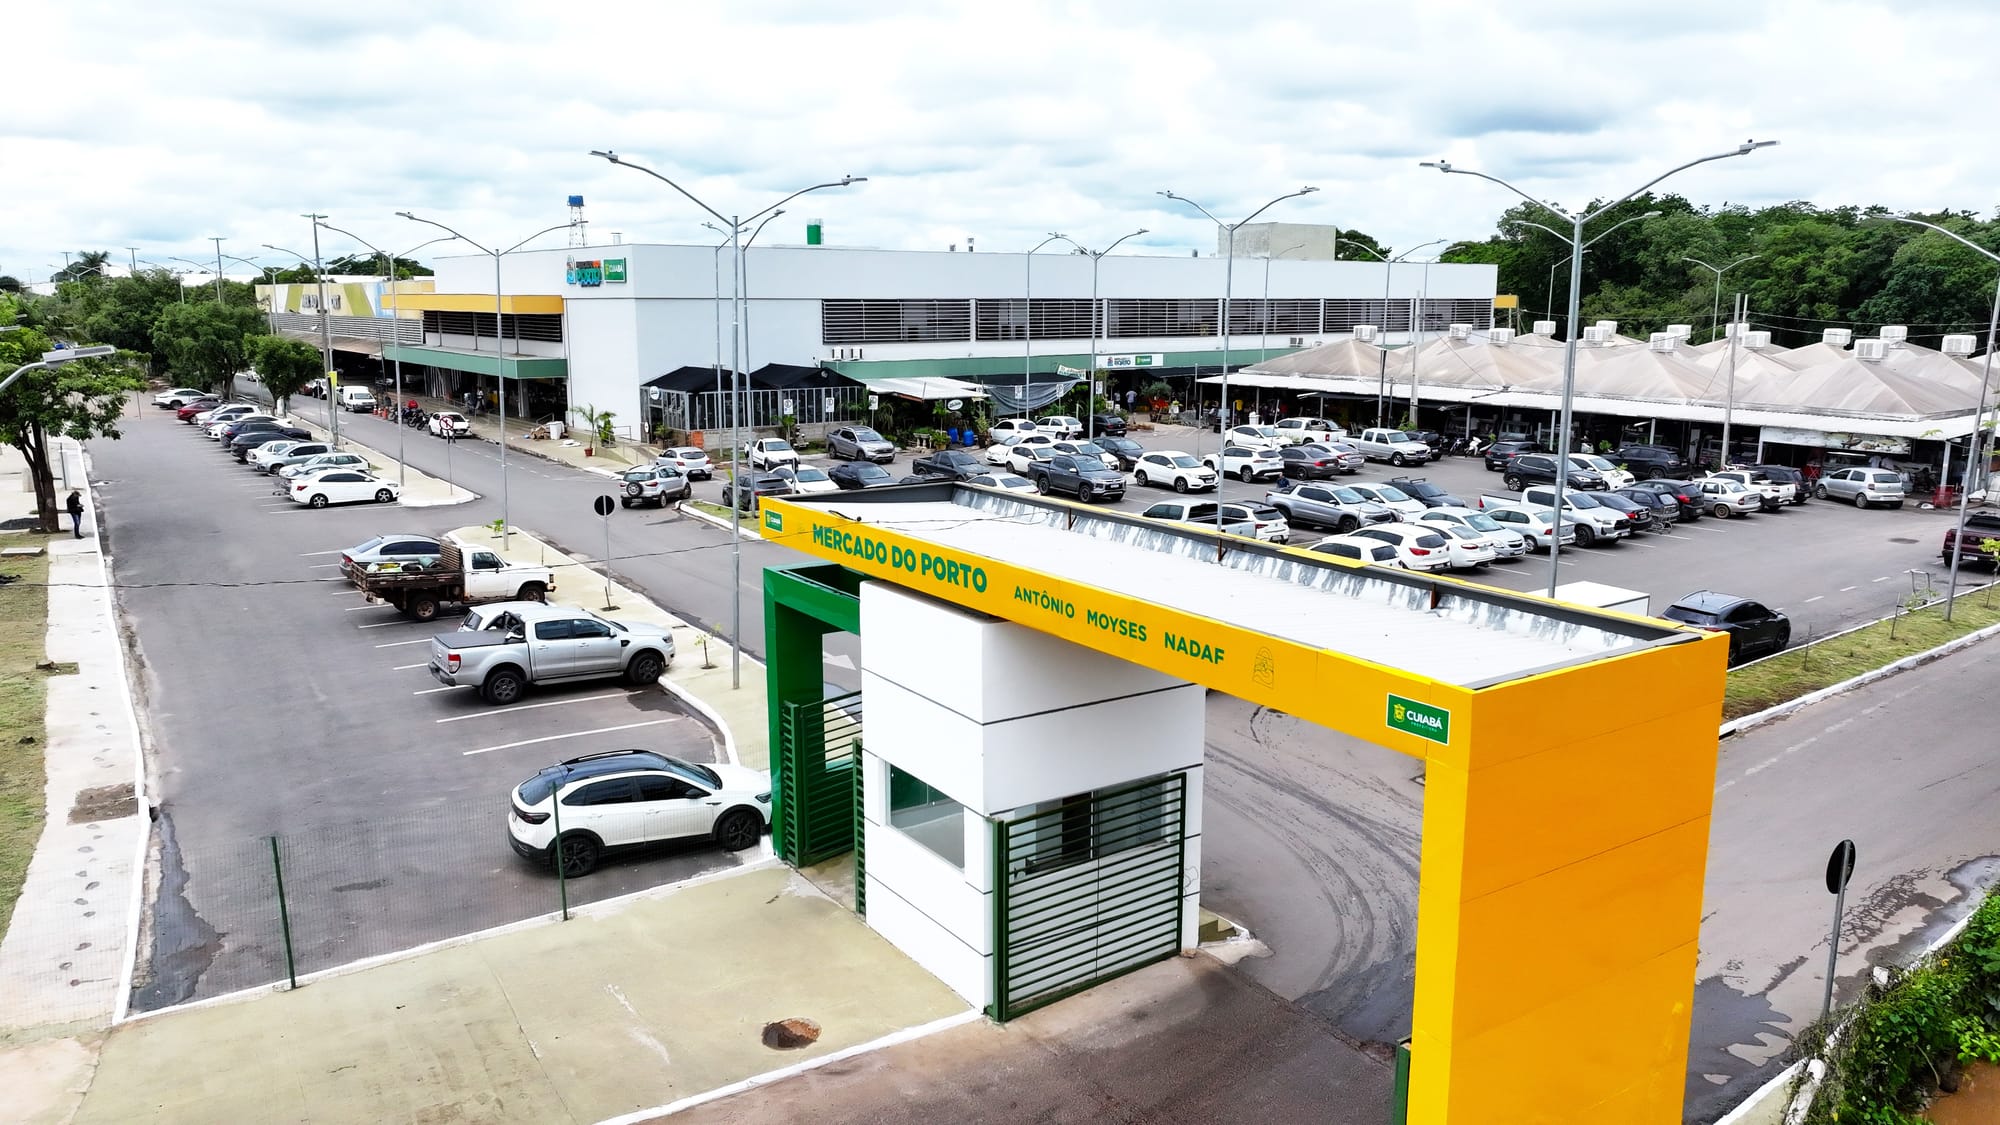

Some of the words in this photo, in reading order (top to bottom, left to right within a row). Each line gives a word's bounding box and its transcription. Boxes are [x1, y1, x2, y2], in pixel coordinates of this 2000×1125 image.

[813, 523, 888, 565] MERCADO
[891, 545, 917, 573] DO
[920, 552, 988, 593] PORTO
[1014, 584, 1076, 619] ANTÔNIO
[1087, 610, 1147, 642] MOYSES
[1164, 632, 1225, 665] NADAF
[1407, 711, 1443, 730] CUIABÁ
